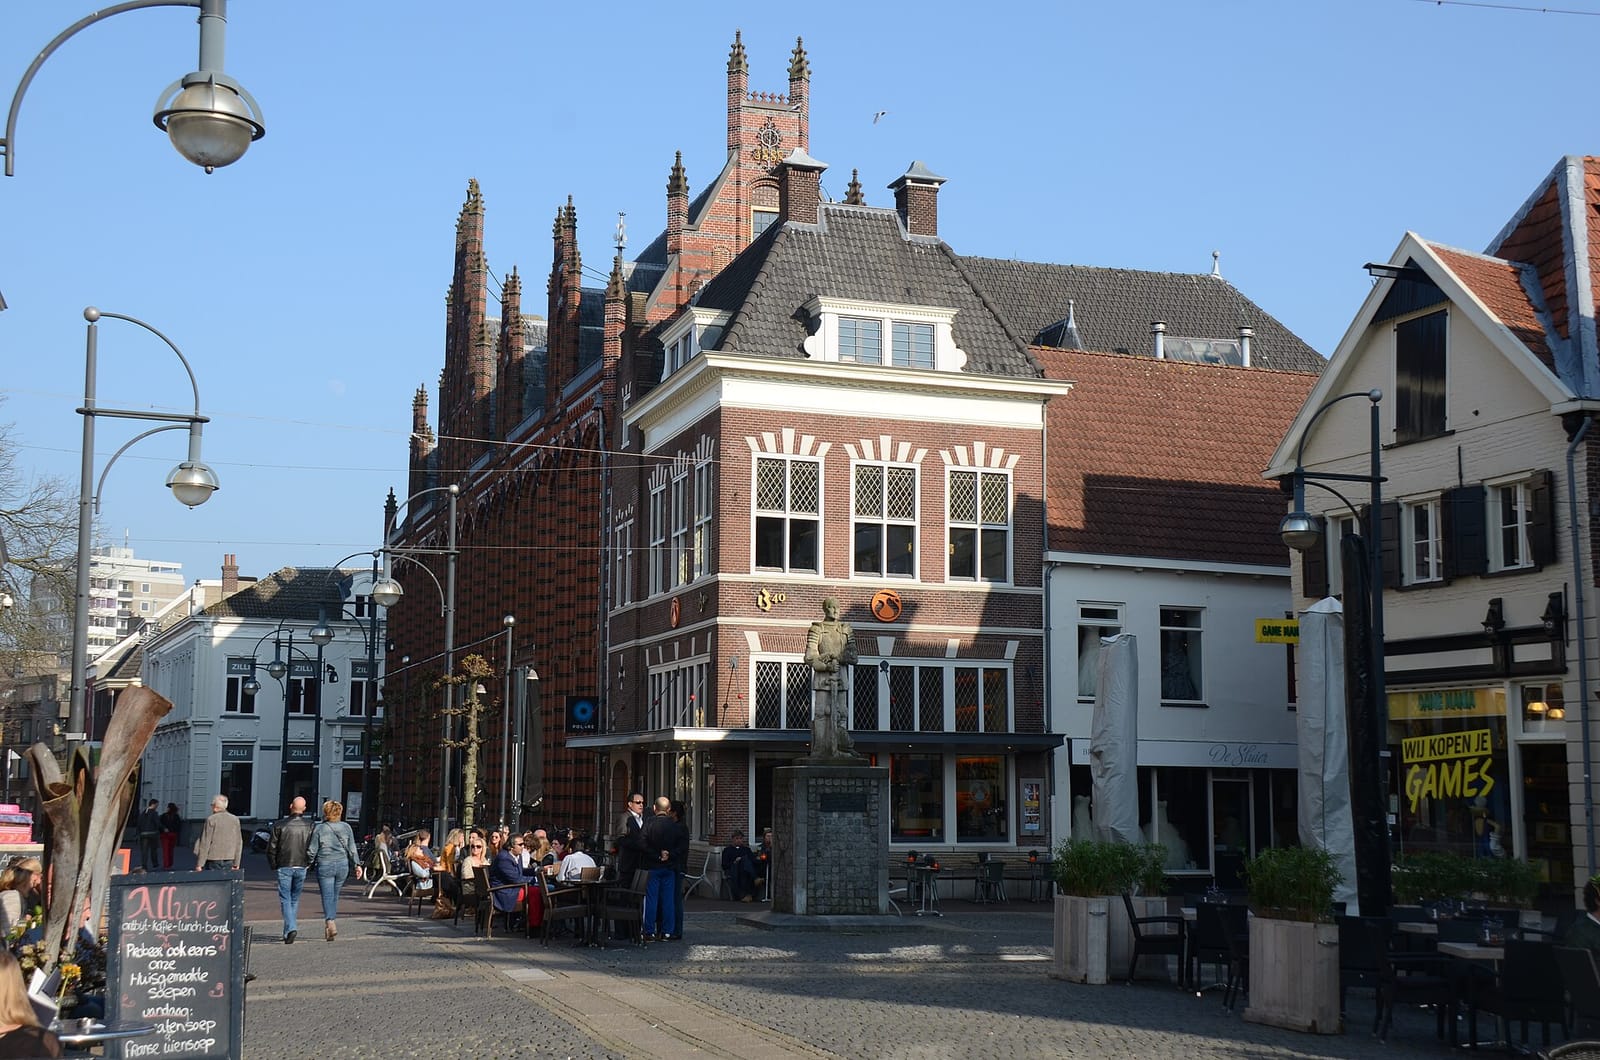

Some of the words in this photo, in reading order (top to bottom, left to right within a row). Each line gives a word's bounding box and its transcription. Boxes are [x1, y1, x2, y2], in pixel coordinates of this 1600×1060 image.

[1262, 625, 1282, 637] GAME
[1284, 625, 1299, 637] MAN
[231, 663, 251, 671] ZILLI
[295, 664, 313, 672] ZILLI
[1404, 740, 1424, 759] WIJ
[1429, 734, 1471, 757] KOPEN
[1475, 732, 1489, 752] JE
[228, 749, 247, 757] ZILLI
[291, 749, 310, 757] ZILLI
[1208, 744, 1231, 762] De
[1232, 745, 1269, 766] Sluier
[1405, 758, 1495, 814] GAMES
[128, 885, 220, 921] Allure
[166, 940, 187, 957] ook
[187, 945, 218, 957] eens
[148, 960, 177, 971] onze
[129, 967, 209, 989] Huisgemaakte
[147, 986, 197, 1000] soepen
